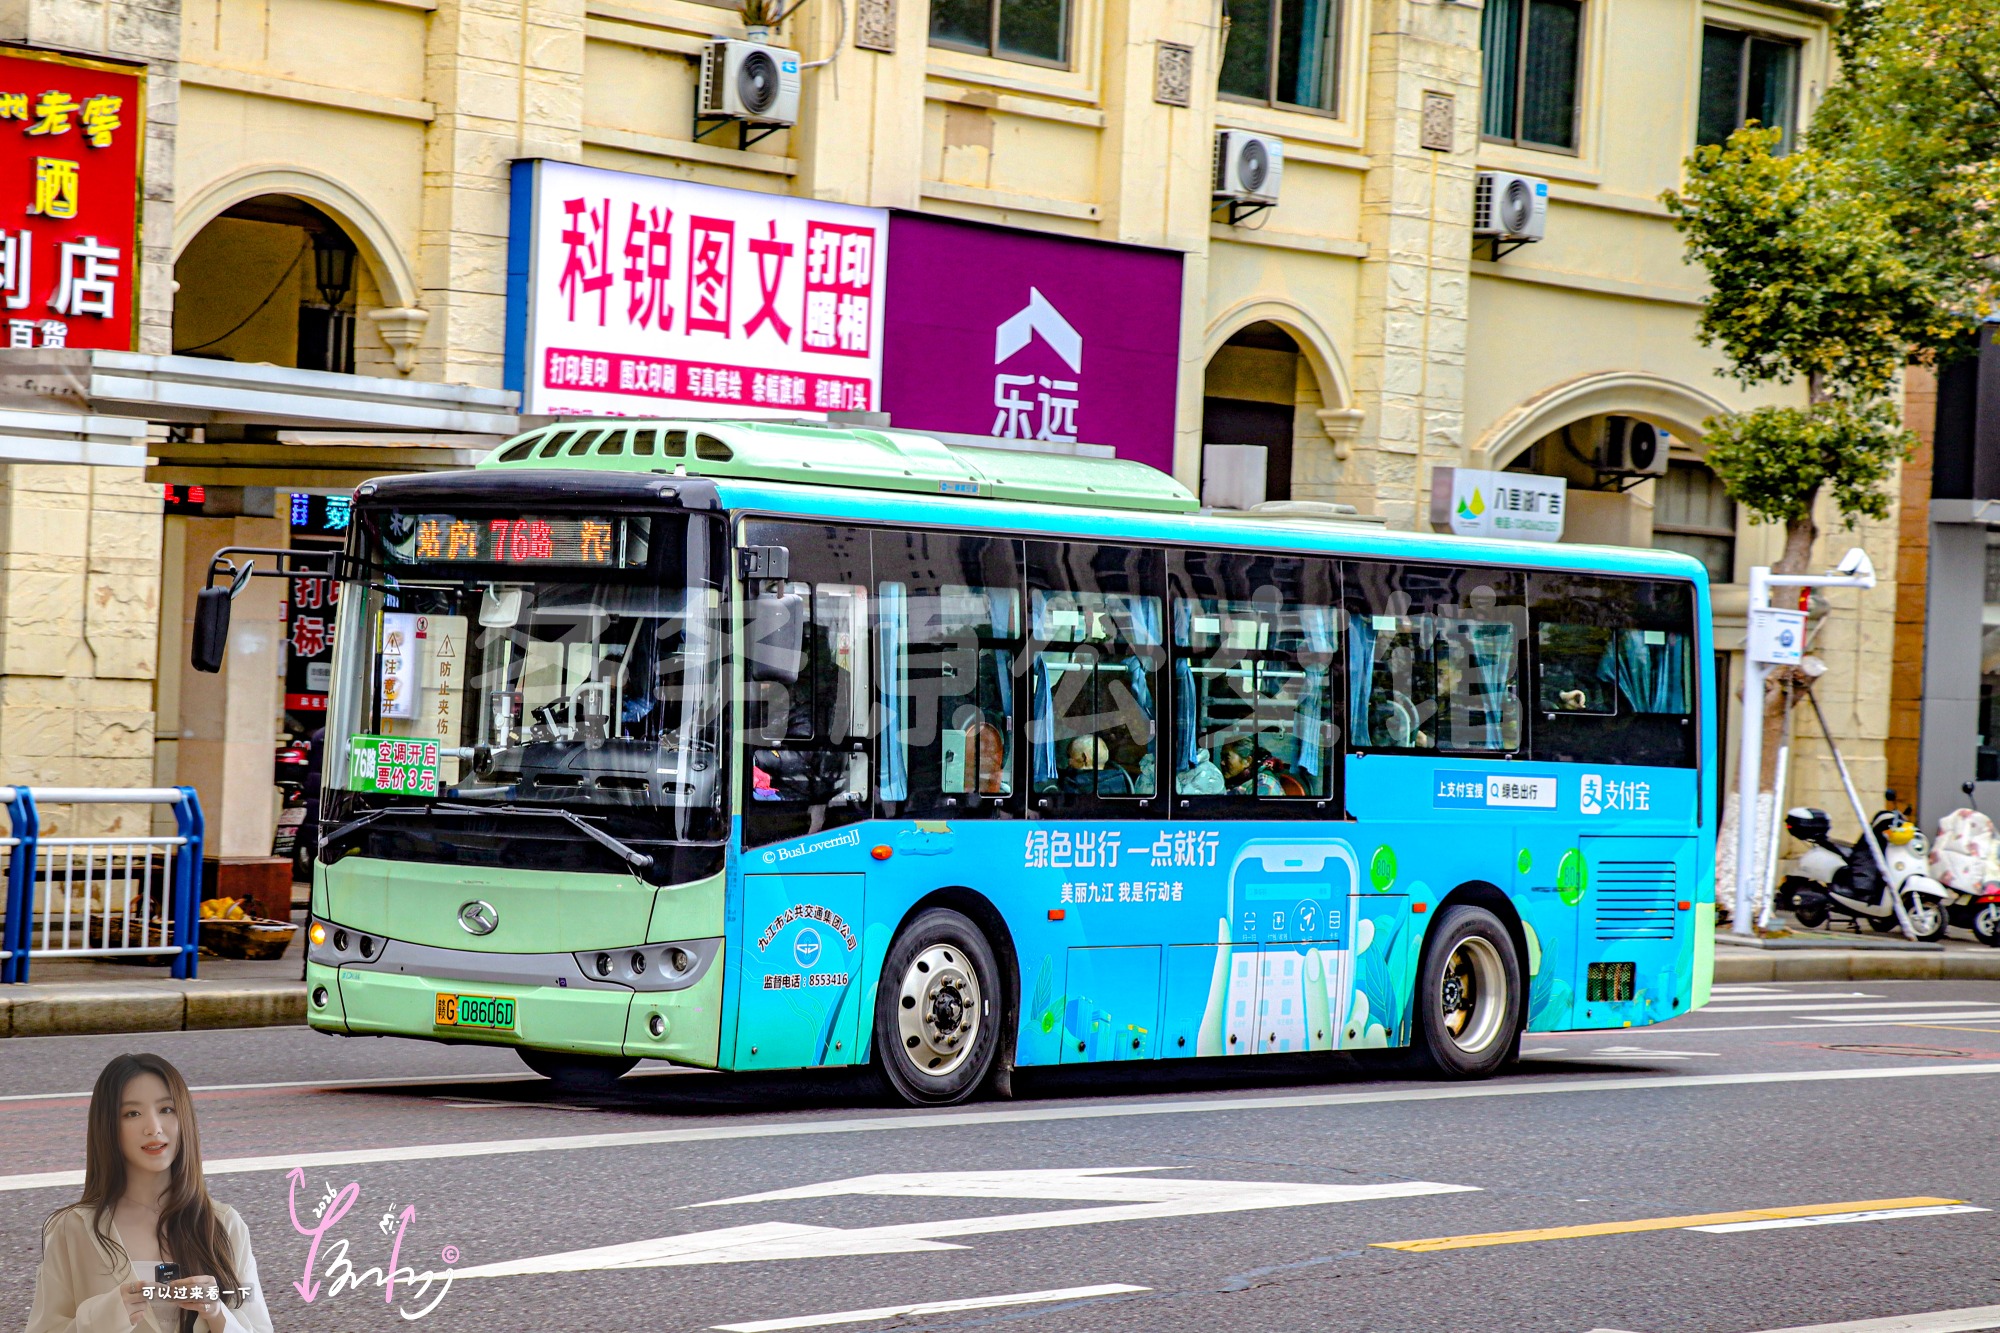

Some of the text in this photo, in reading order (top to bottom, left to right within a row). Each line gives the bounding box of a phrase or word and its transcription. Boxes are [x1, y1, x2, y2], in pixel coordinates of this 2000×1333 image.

[30, 156, 80, 219] 酒
[559, 197, 795, 345] 科锐图文
[807, 228, 874, 288] 打印
[8, 319, 68, 348] 百货
[804, 291, 870, 351] 照相
[550, 353, 609, 387] 打印复印
[619, 360, 678, 394] 图文印刷
[991, 373, 1079, 443] 乐远
[490, 519, 552, 562] 76路
[381, 659, 398, 734] 注意开门
[437, 661, 452, 735] 防止夹伤
[354, 748, 377, 778] 76路
[378, 741, 437, 767] 空调开启
[376, 766, 435, 791] 票价3元
[1437, 781, 1538, 800] 上支付宝搜 绿色出行
[1603, 780, 1650, 811] 支付宝
[1024, 830, 1220, 868] 绿色出行 一点就行
[1060, 881, 1184, 904] 美丽九江 我是行动者
[757, 903, 858, 952] 九江市公共交通集团公司
